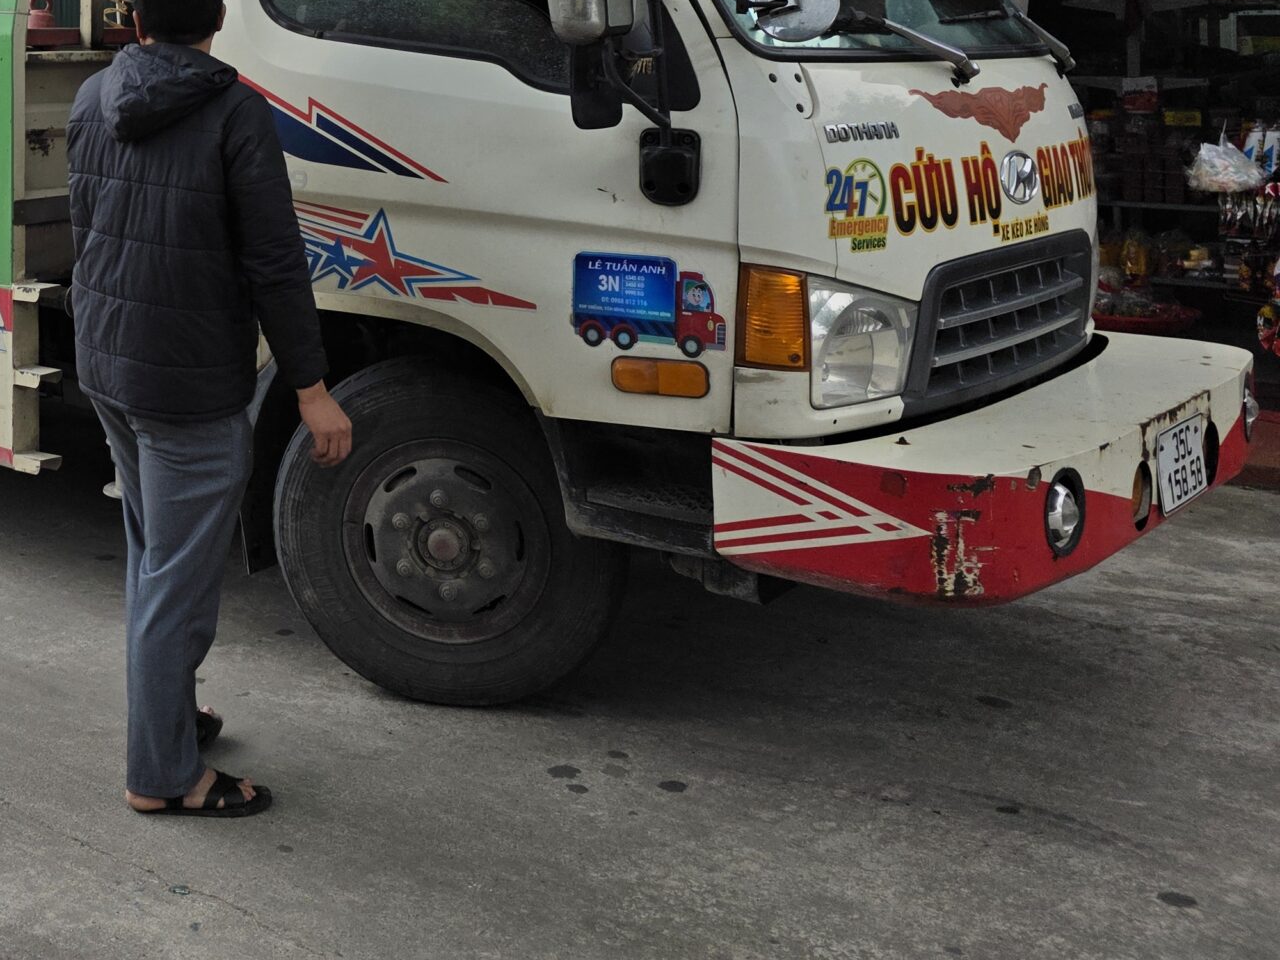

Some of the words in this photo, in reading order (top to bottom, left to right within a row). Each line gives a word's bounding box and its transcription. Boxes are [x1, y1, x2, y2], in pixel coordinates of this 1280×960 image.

[824, 121, 900, 143] DOTHANH
[890, 147, 958, 235] CỨU
[961, 141, 1002, 237] HỘ
[1036, 143, 1074, 210] GIAO
[830, 217, 889, 236] Emergency
[1001, 224, 1010, 241] XE
[1011, 218, 1024, 239] KÉO
[1024, 219, 1033, 236] XE
[852, 236, 886, 251] Services
[588, 259, 602, 270] LÊ
[605, 259, 637, 272] TUẤN
[640, 265, 666, 275] ANH
[598, 274, 620, 292] 3N
[1172, 424, 1192, 463] 35C
[1168, 455, 1203, 505] 158.58
